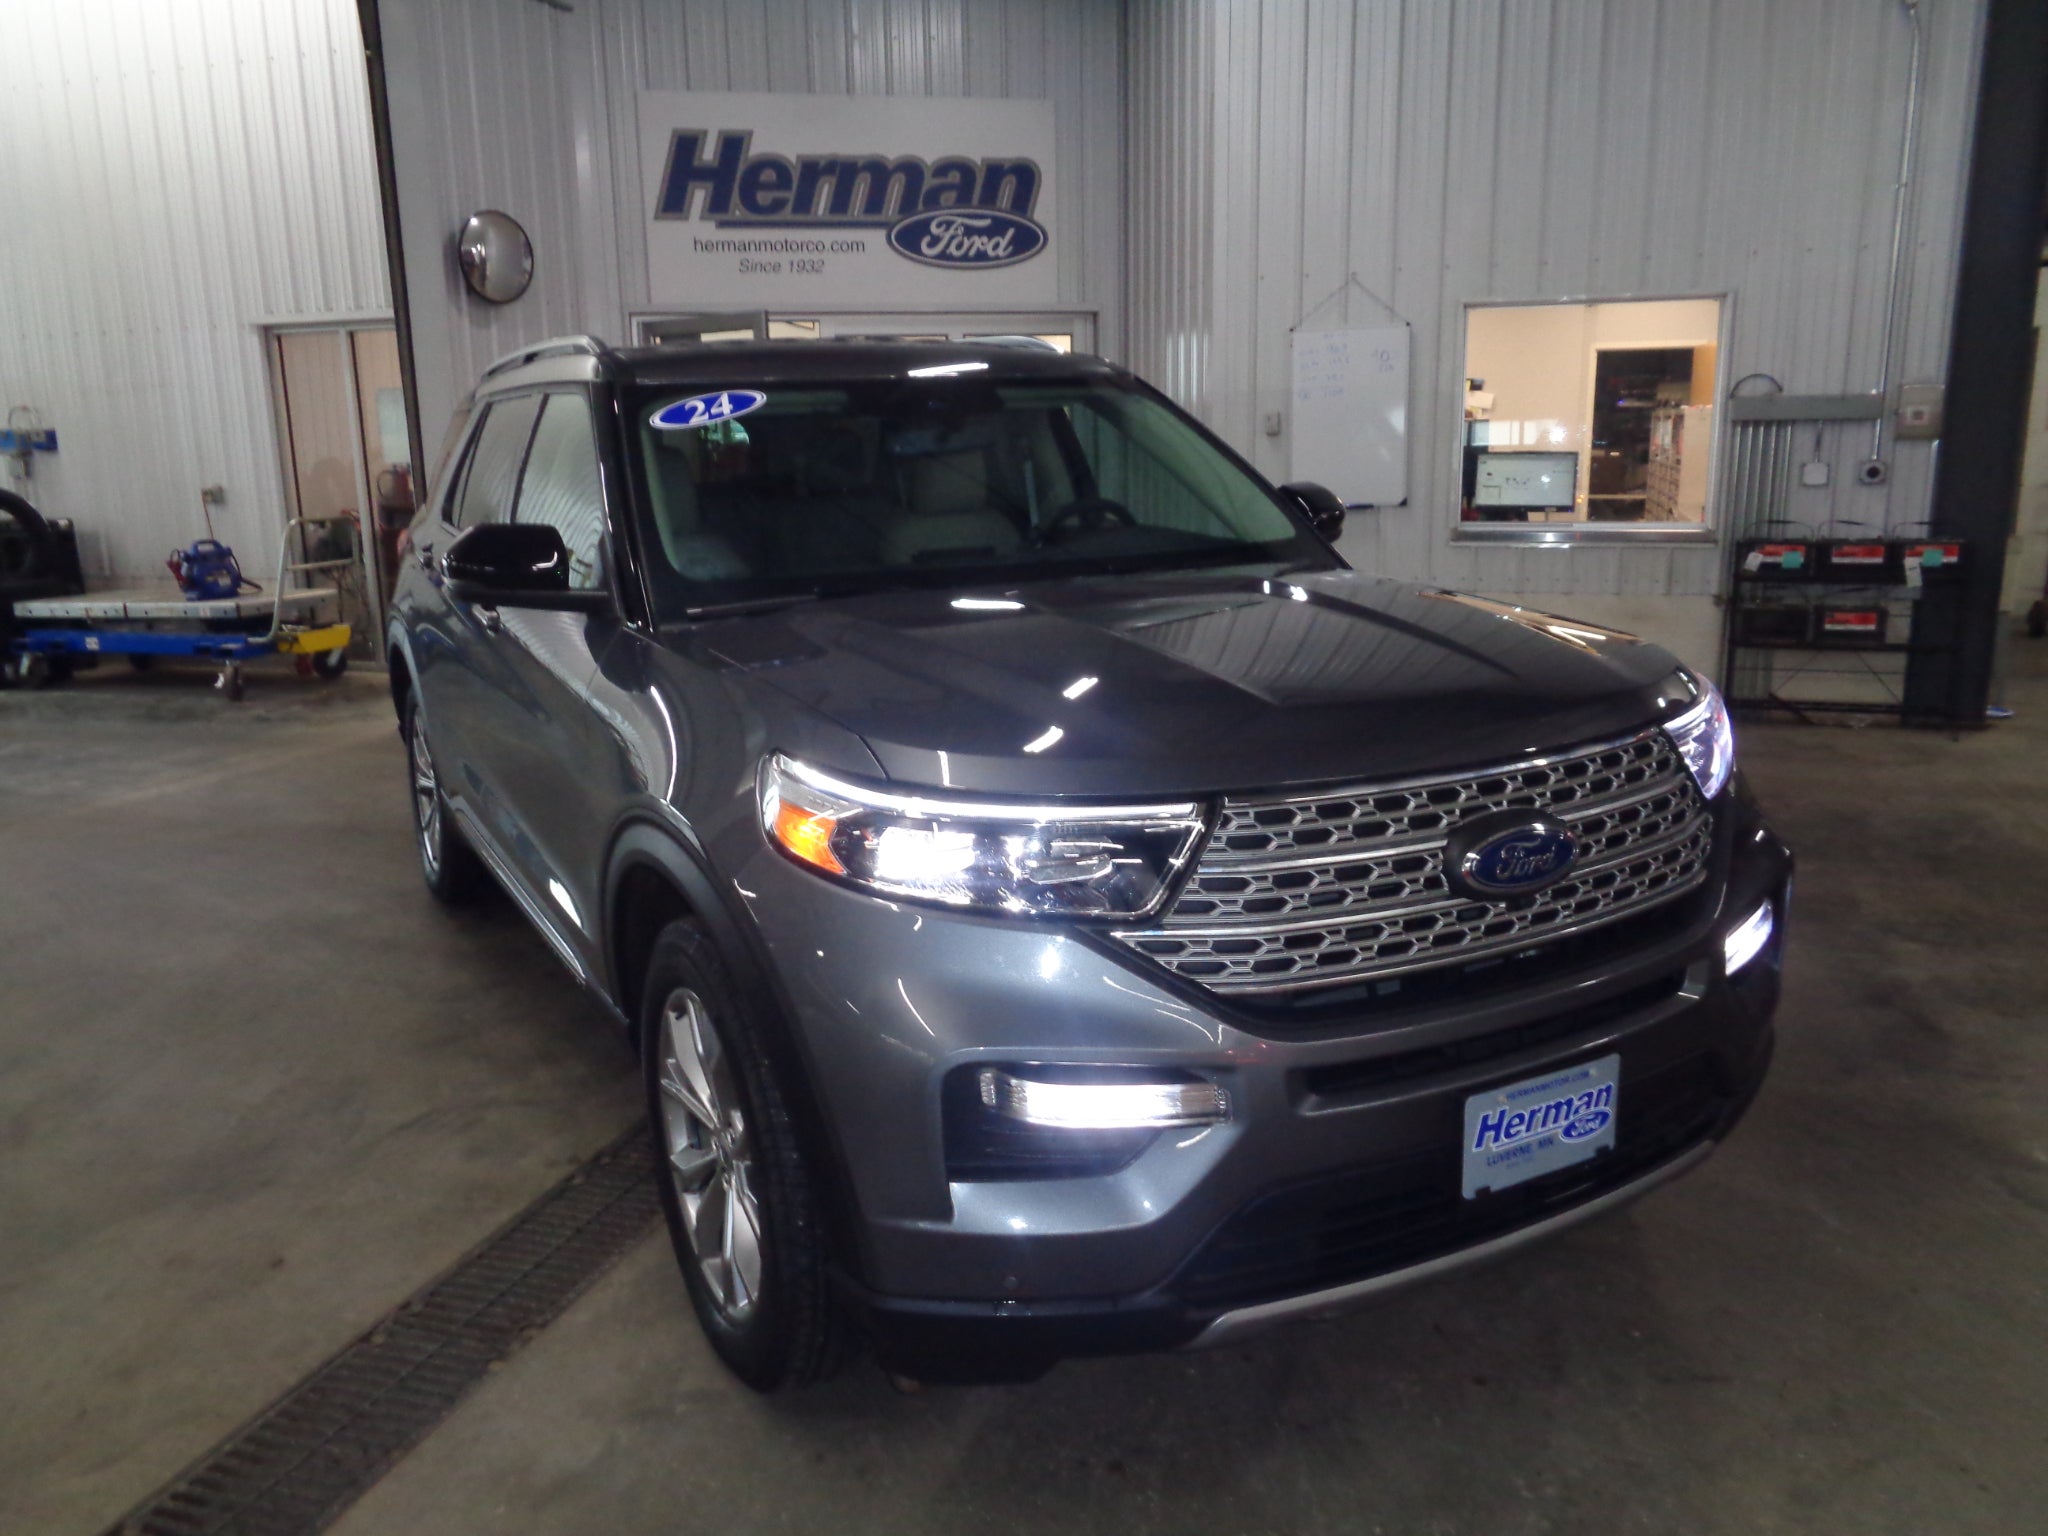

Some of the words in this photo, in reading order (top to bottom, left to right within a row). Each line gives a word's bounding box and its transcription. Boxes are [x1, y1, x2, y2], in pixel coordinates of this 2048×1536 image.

[654, 128, 1042, 220] Herman
[694, 236, 866, 253] hermanmotorco.com
[920, 214, 1013, 258] Ford
[738, 258, 782, 274] Since
[787, 258, 825, 274] 1932
[684, 391, 734, 425] 24
[1496, 838, 1556, 880] Ford
[1472, 1082, 1614, 1151] Herman
